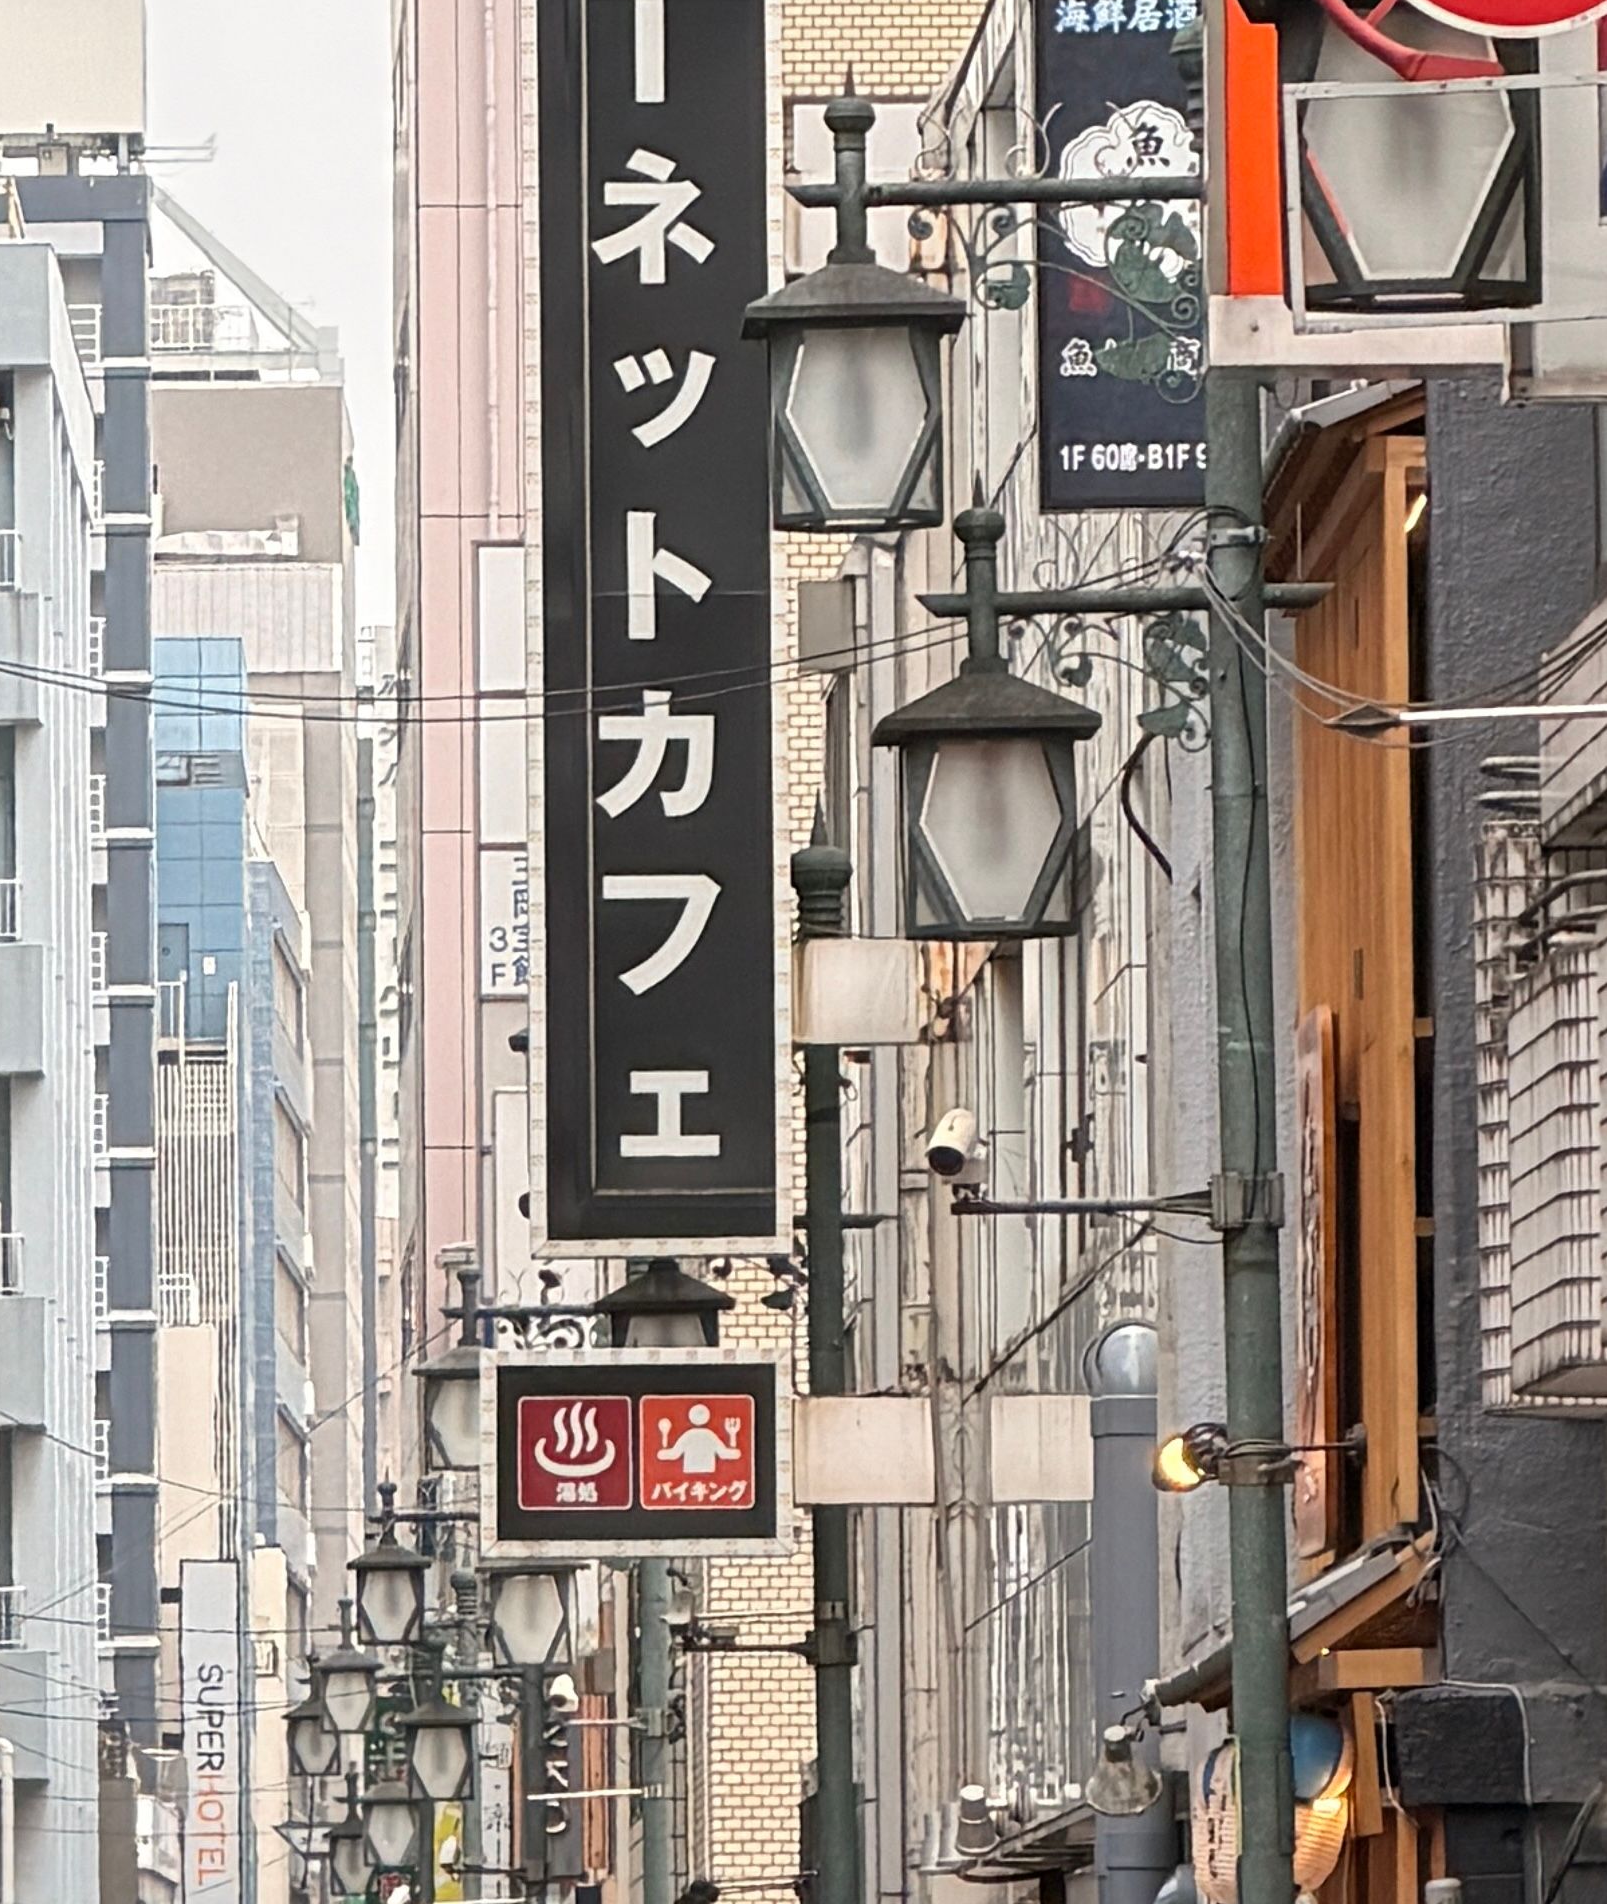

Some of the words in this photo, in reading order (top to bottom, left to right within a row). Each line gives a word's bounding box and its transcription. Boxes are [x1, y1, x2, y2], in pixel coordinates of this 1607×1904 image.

[650, 1479, 748, 1502] バイキング
[197, 1663, 225, 1771] SUPER
[197, 1773, 226, 1886] HOTEL
